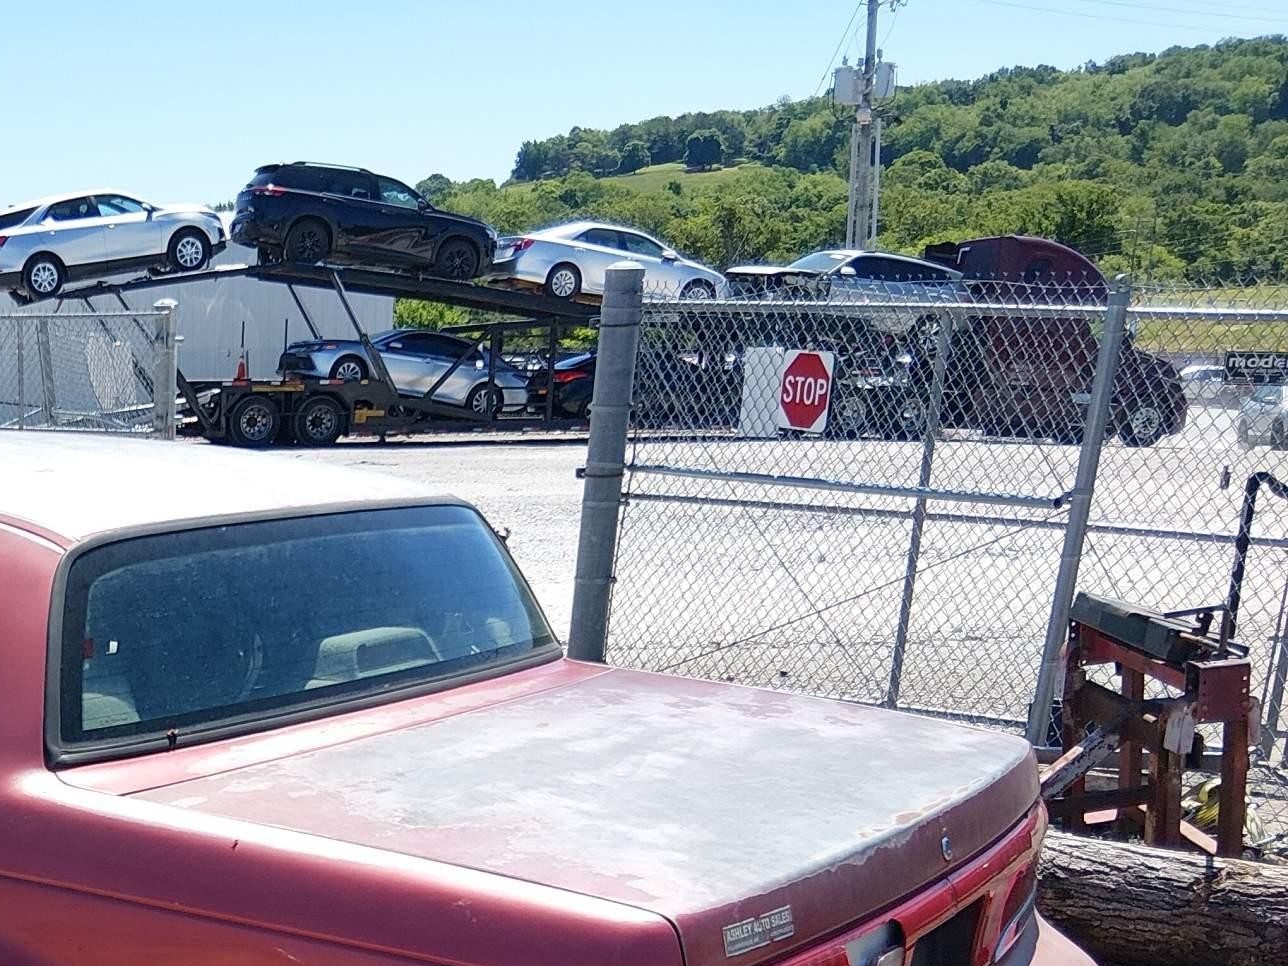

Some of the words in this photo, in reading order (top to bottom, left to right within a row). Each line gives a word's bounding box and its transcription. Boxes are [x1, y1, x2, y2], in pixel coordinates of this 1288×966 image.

[783, 376, 827, 406] STOP
[726, 923, 752, 942] ASHLEY
[753, 917, 771, 934] AUTO
[771, 910, 790, 928] SALES
